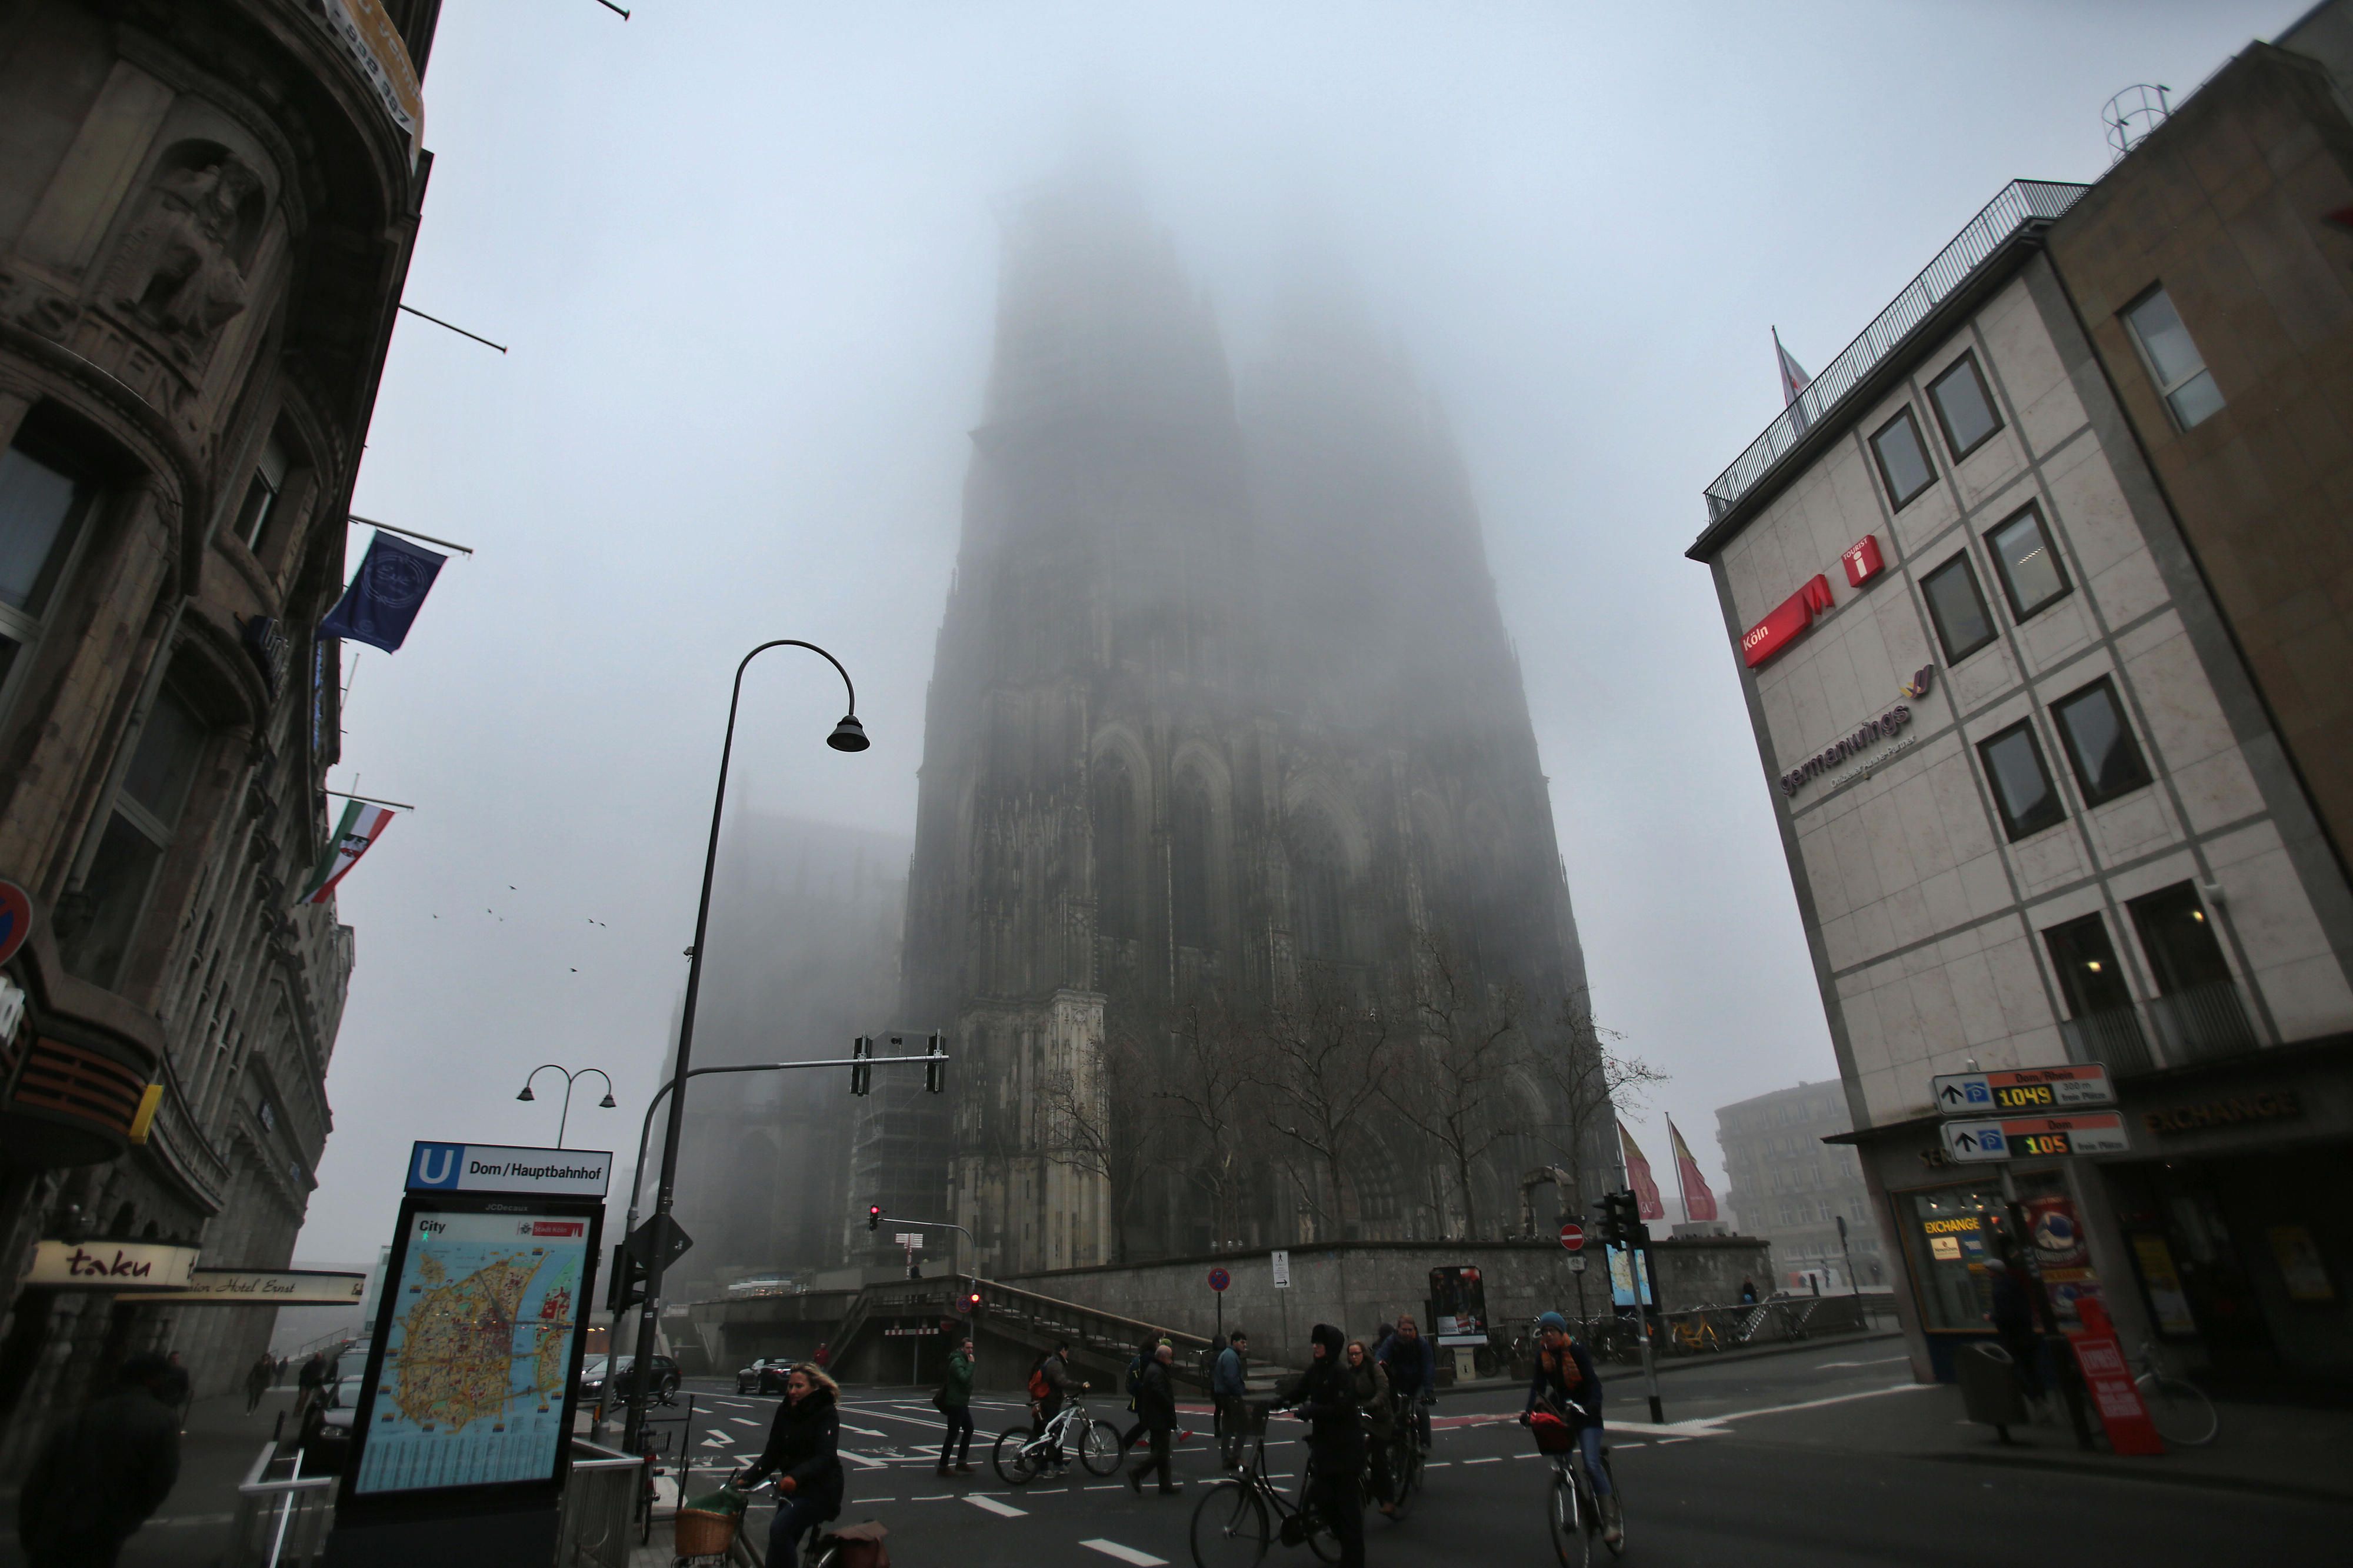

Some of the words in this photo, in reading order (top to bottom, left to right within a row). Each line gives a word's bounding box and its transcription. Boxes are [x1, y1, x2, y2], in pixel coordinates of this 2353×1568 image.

[345, 23, 379, 75] 938
[1842, 537, 1868, 561] TOURIST
[1742, 625, 1769, 651] Köln
[1780, 705, 1911, 796] germanwings
[2014, 1070, 2074, 1083] Dom/Rhein
[2062, 1082, 2082, 1091] 300
[1999, 1086, 2053, 1107] 1049
[2143, 1091, 2302, 1134] EXCHANGE
[2047, 1120, 2073, 1130] Dom
[2024, 1135, 2069, 1155] 105
[418, 1148, 455, 1184] U
[485, 1203, 528, 1212] JCDecaux
[419, 1220, 445, 1234] City
[1924, 1217, 1981, 1233] EXCHANGE
[66, 1248, 151, 1277] taku
[216, 1278, 261, 1292] Hotel
[262, 1279, 296, 1293] Ernst
